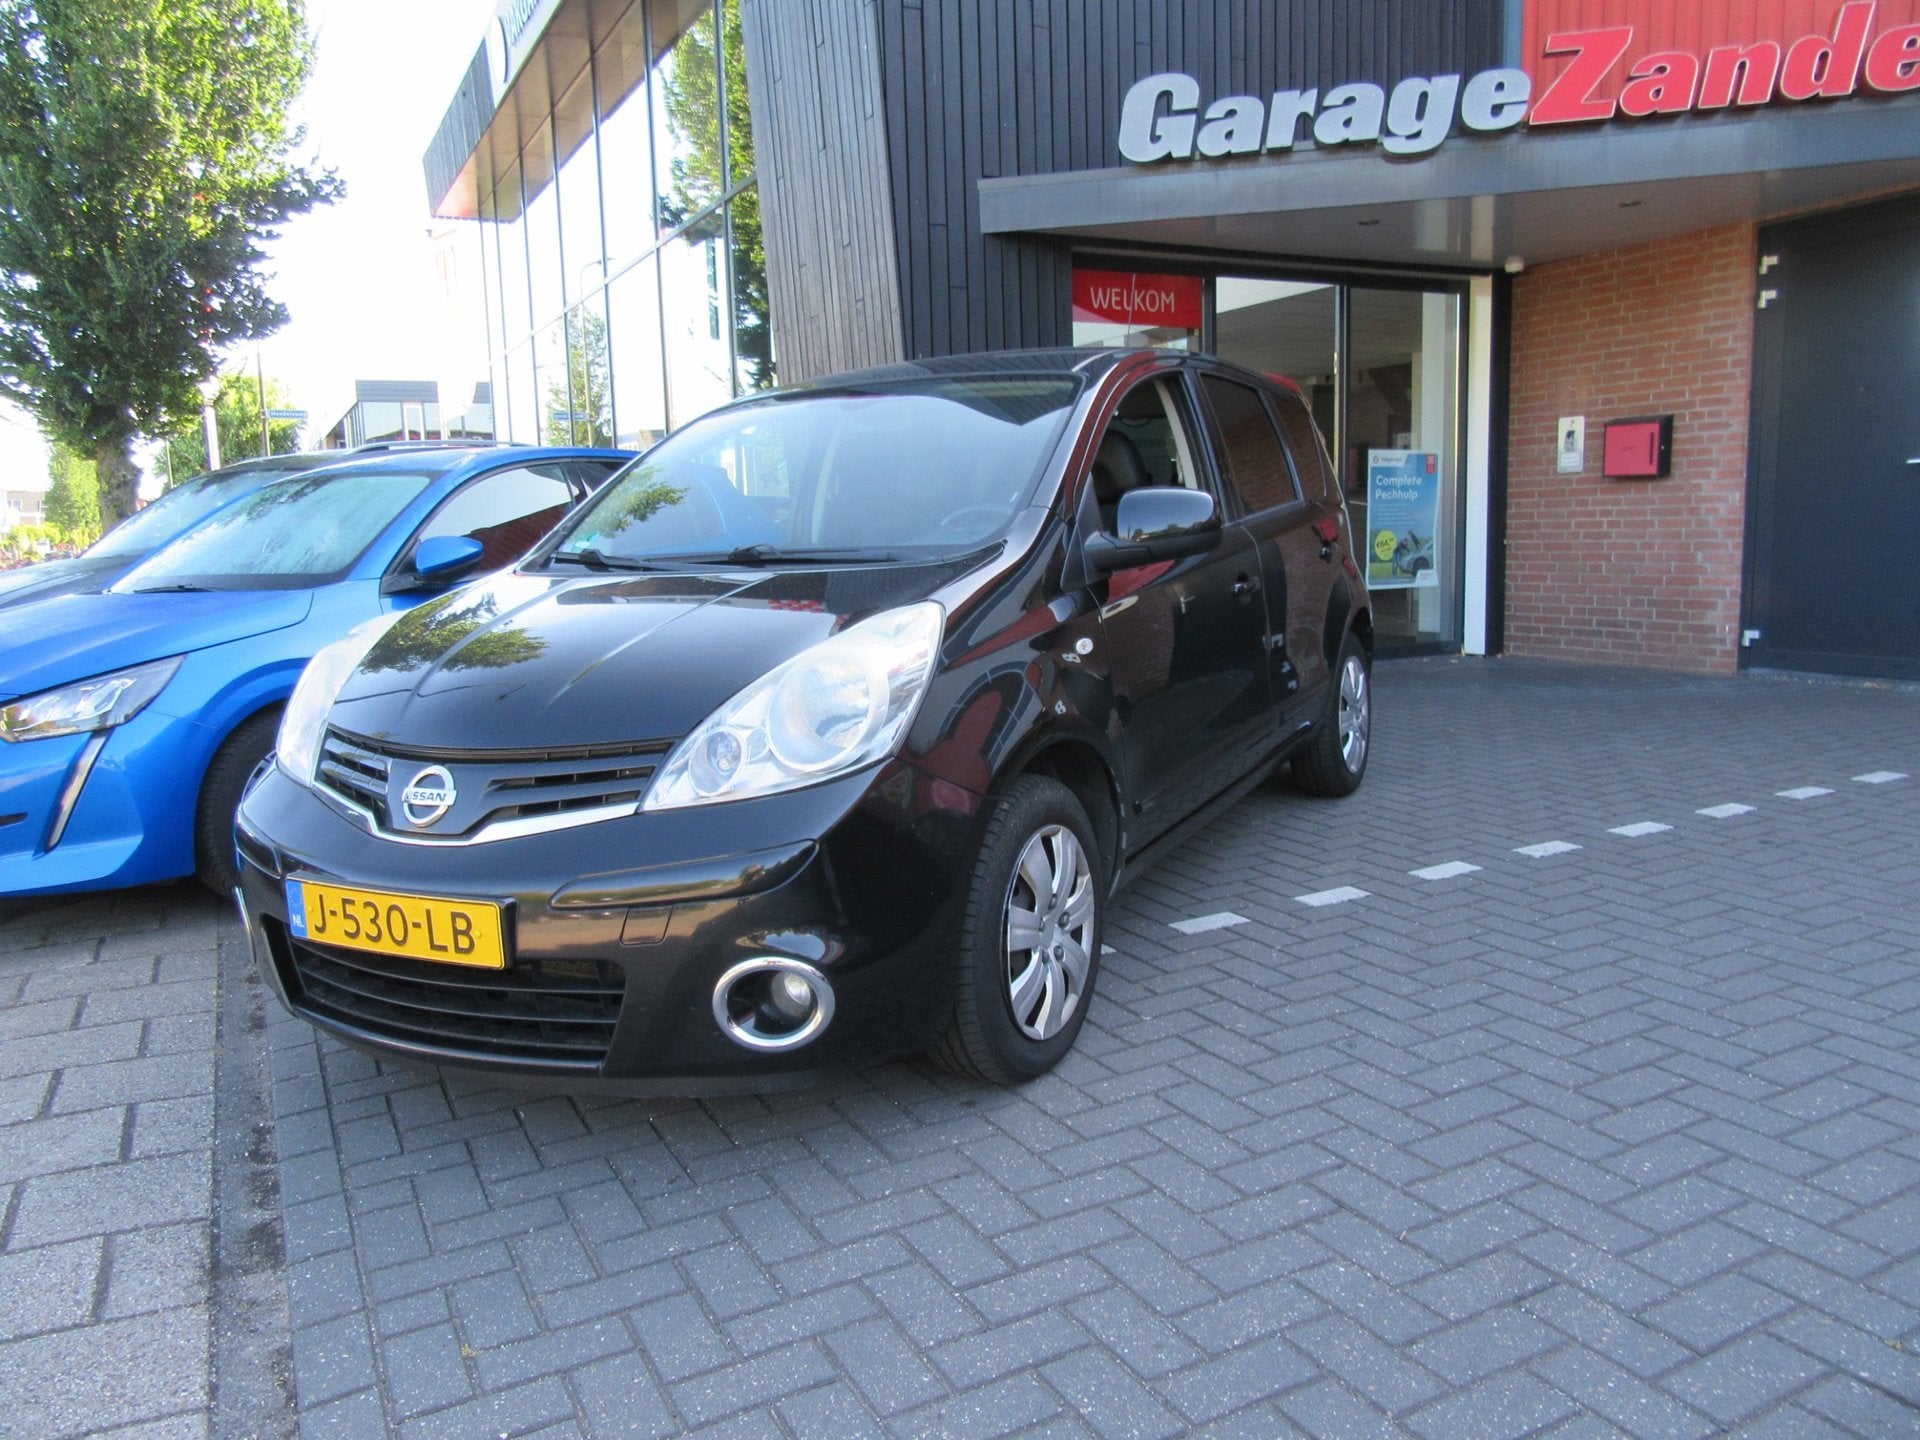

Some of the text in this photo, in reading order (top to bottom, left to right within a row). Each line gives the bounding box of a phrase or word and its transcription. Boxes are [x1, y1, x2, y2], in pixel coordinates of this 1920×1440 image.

[1118, 1, 1920, 163] Garage Zande
[1090, 286, 1175, 313] WELKOM
[1375, 475, 1423, 489] Complete
[1375, 489, 1418, 502] Pechhulp
[292, 914, 305, 929] NL
[314, 894, 476, 955] J-530-LB
